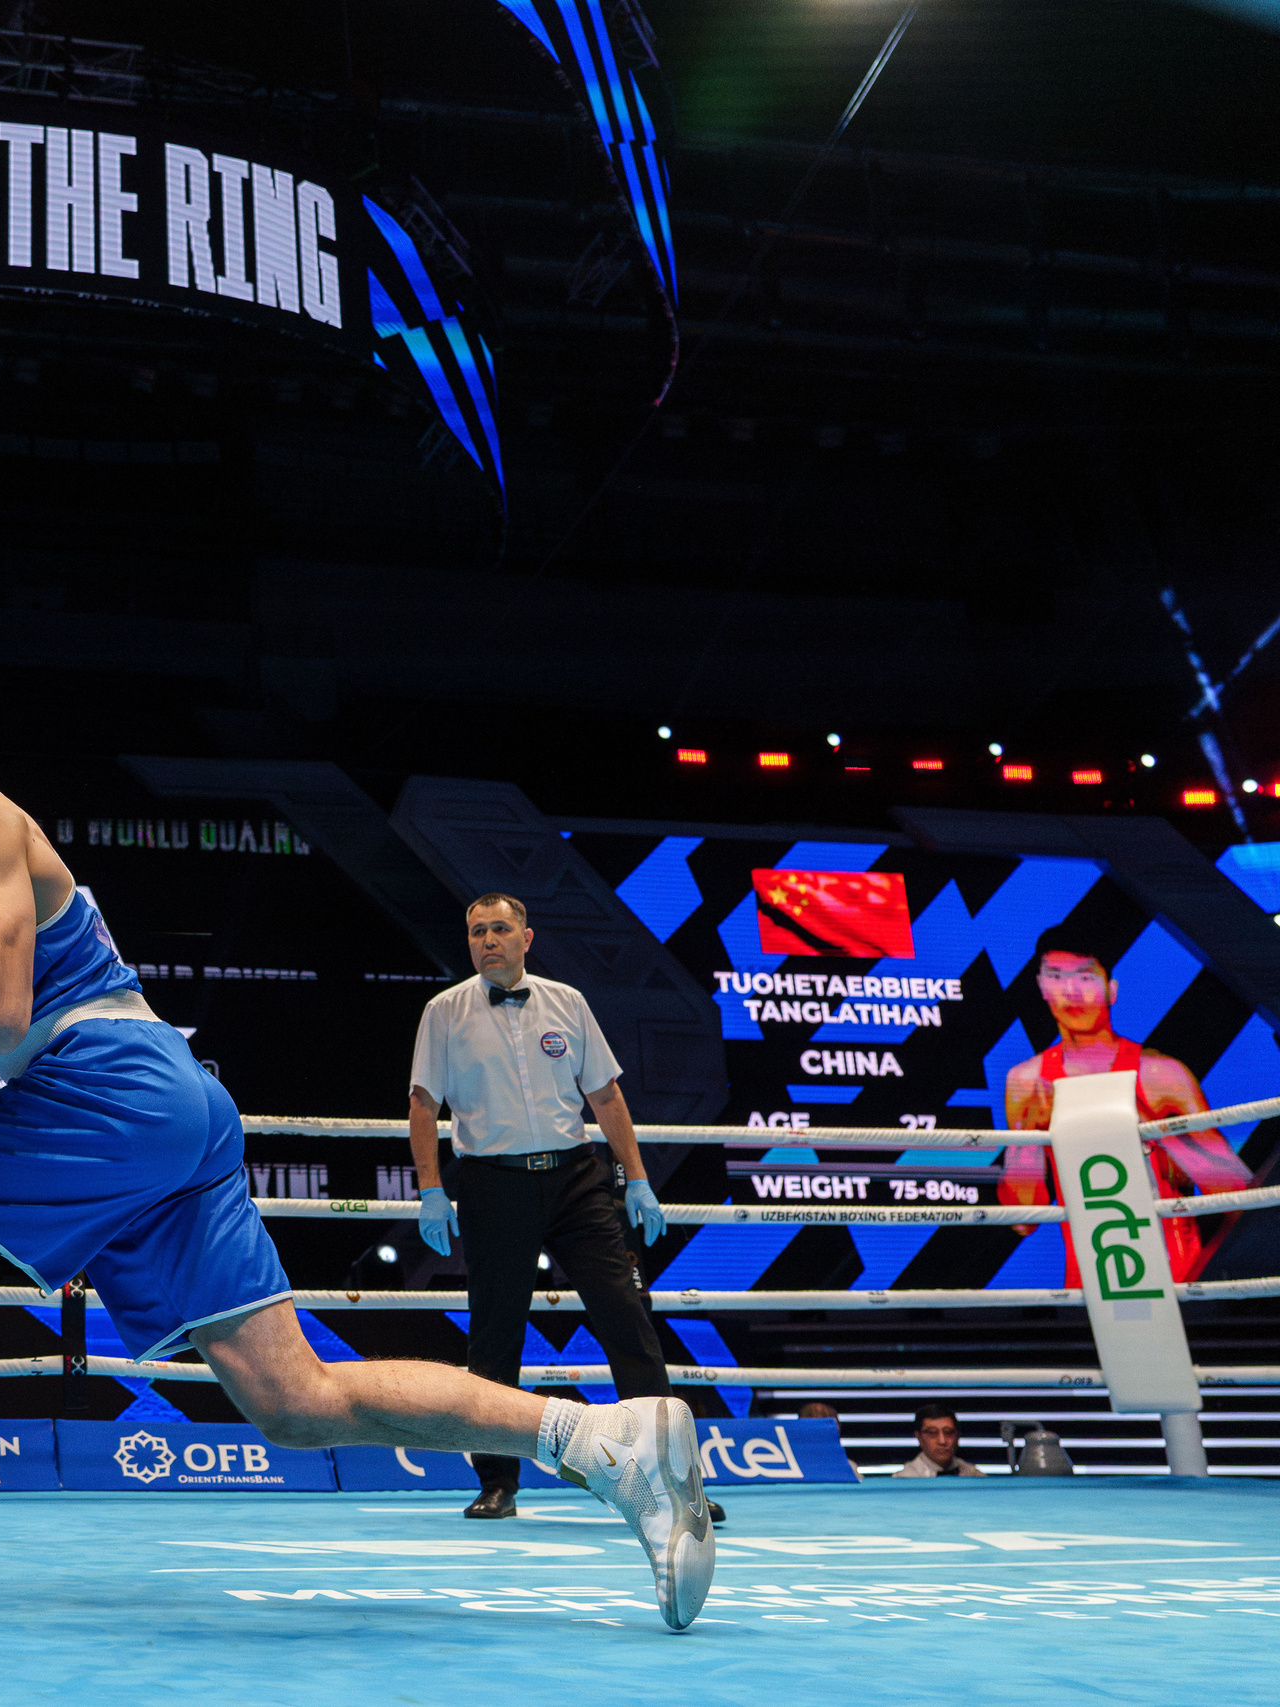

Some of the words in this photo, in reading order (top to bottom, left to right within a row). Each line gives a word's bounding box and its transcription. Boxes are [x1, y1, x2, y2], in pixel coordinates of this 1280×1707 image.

[165, 142, 342, 330] RING
[713, 971, 963, 1001] TUOHETAERBIEKE
[743, 999, 942, 1027] TANGLATIHAN
[800, 1049, 904, 1077] CHINA
[747, 1111, 810, 1128] AGE
[751, 1175, 870, 1199] WEIGHT
[889, 1180, 979, 1204] 75-80kg
[330, 1200, 368, 1212] artel
[761, 1210, 836, 1223] UZBEKISTAN
[839, 1210, 886, 1222] BOXING
[890, 1210, 963, 1222] FEDERATION
[1079, 1154, 1165, 1301] artel
[183, 1443, 270, 1472] OFB
[699, 1425, 804, 1479] rtel
[222, 1586, 635, 1601] MENS
